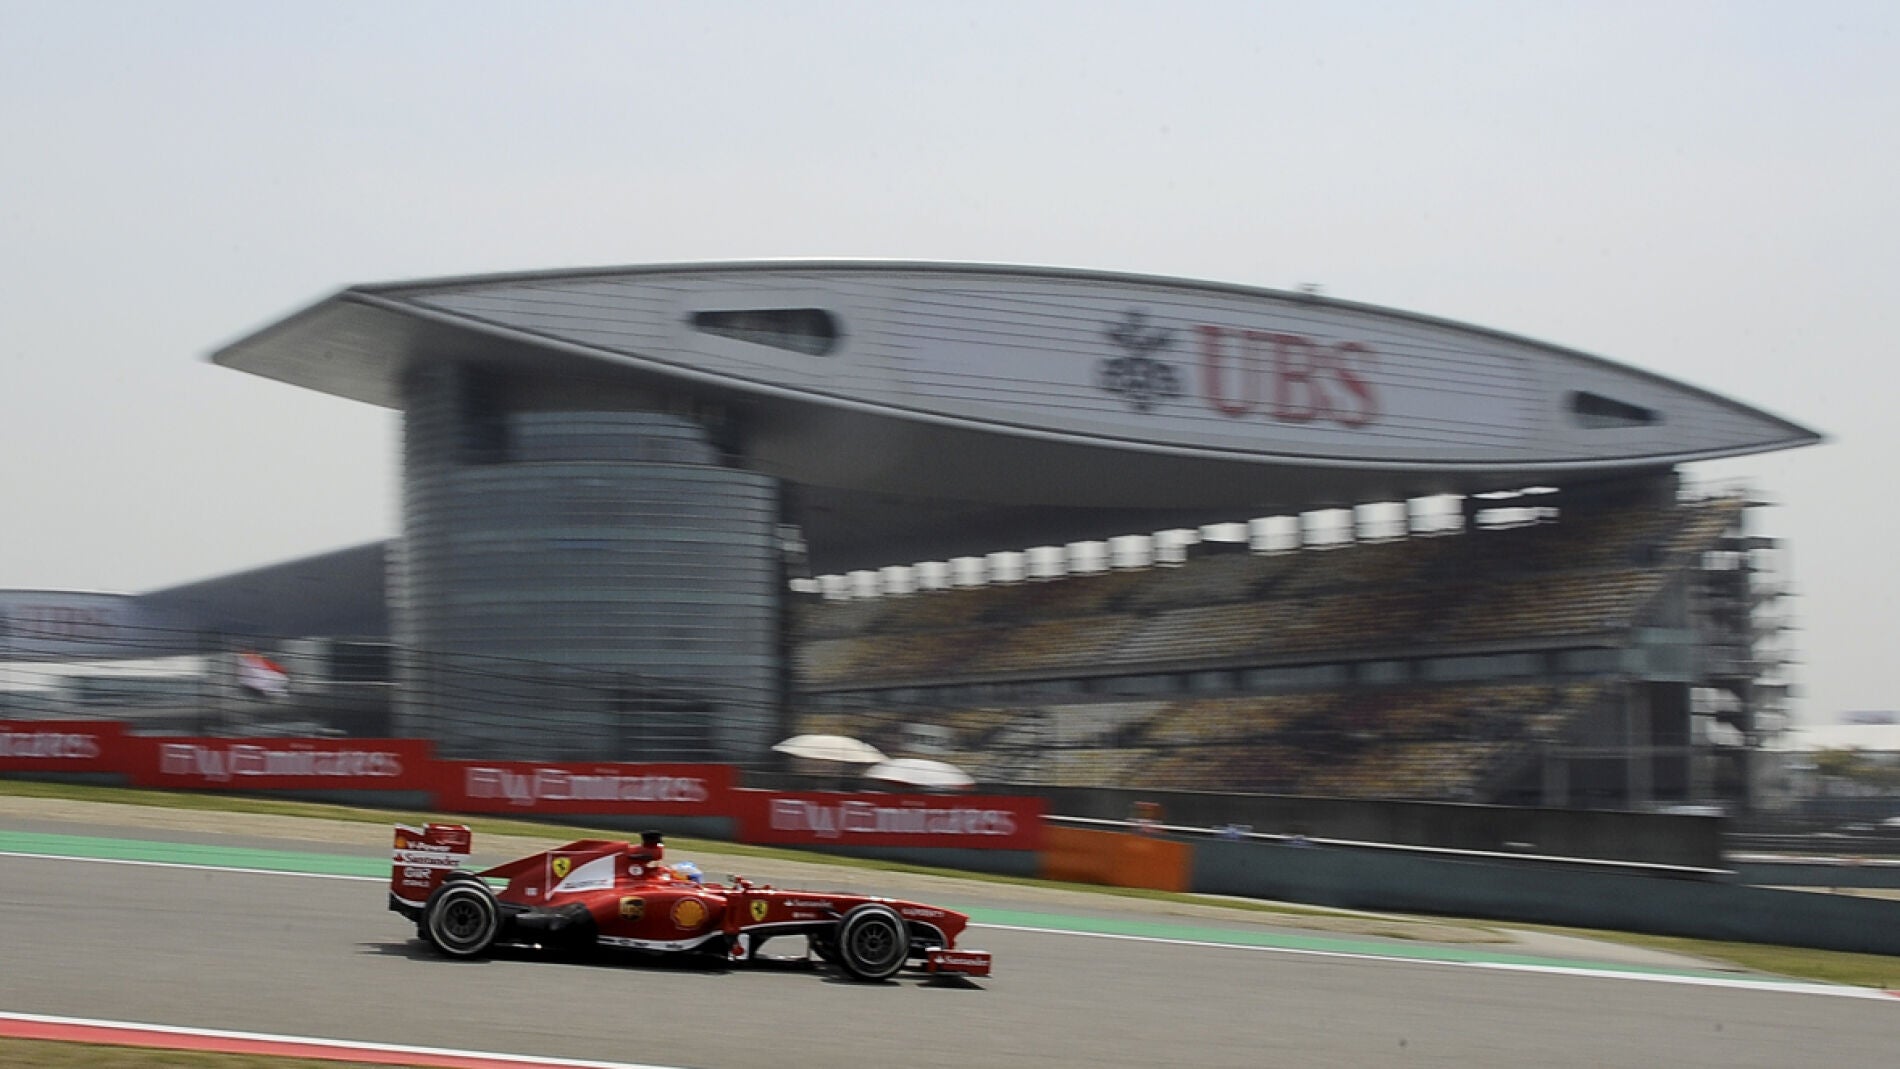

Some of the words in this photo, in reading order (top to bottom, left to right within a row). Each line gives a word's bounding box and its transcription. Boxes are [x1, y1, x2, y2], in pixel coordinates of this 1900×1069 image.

[1194, 323, 1381, 428] UBS
[229, 743, 402, 776] Emirates
[534, 768, 708, 802] Emirates
[839, 800, 1017, 835] Emirates
[405, 853, 460, 866] Santander
